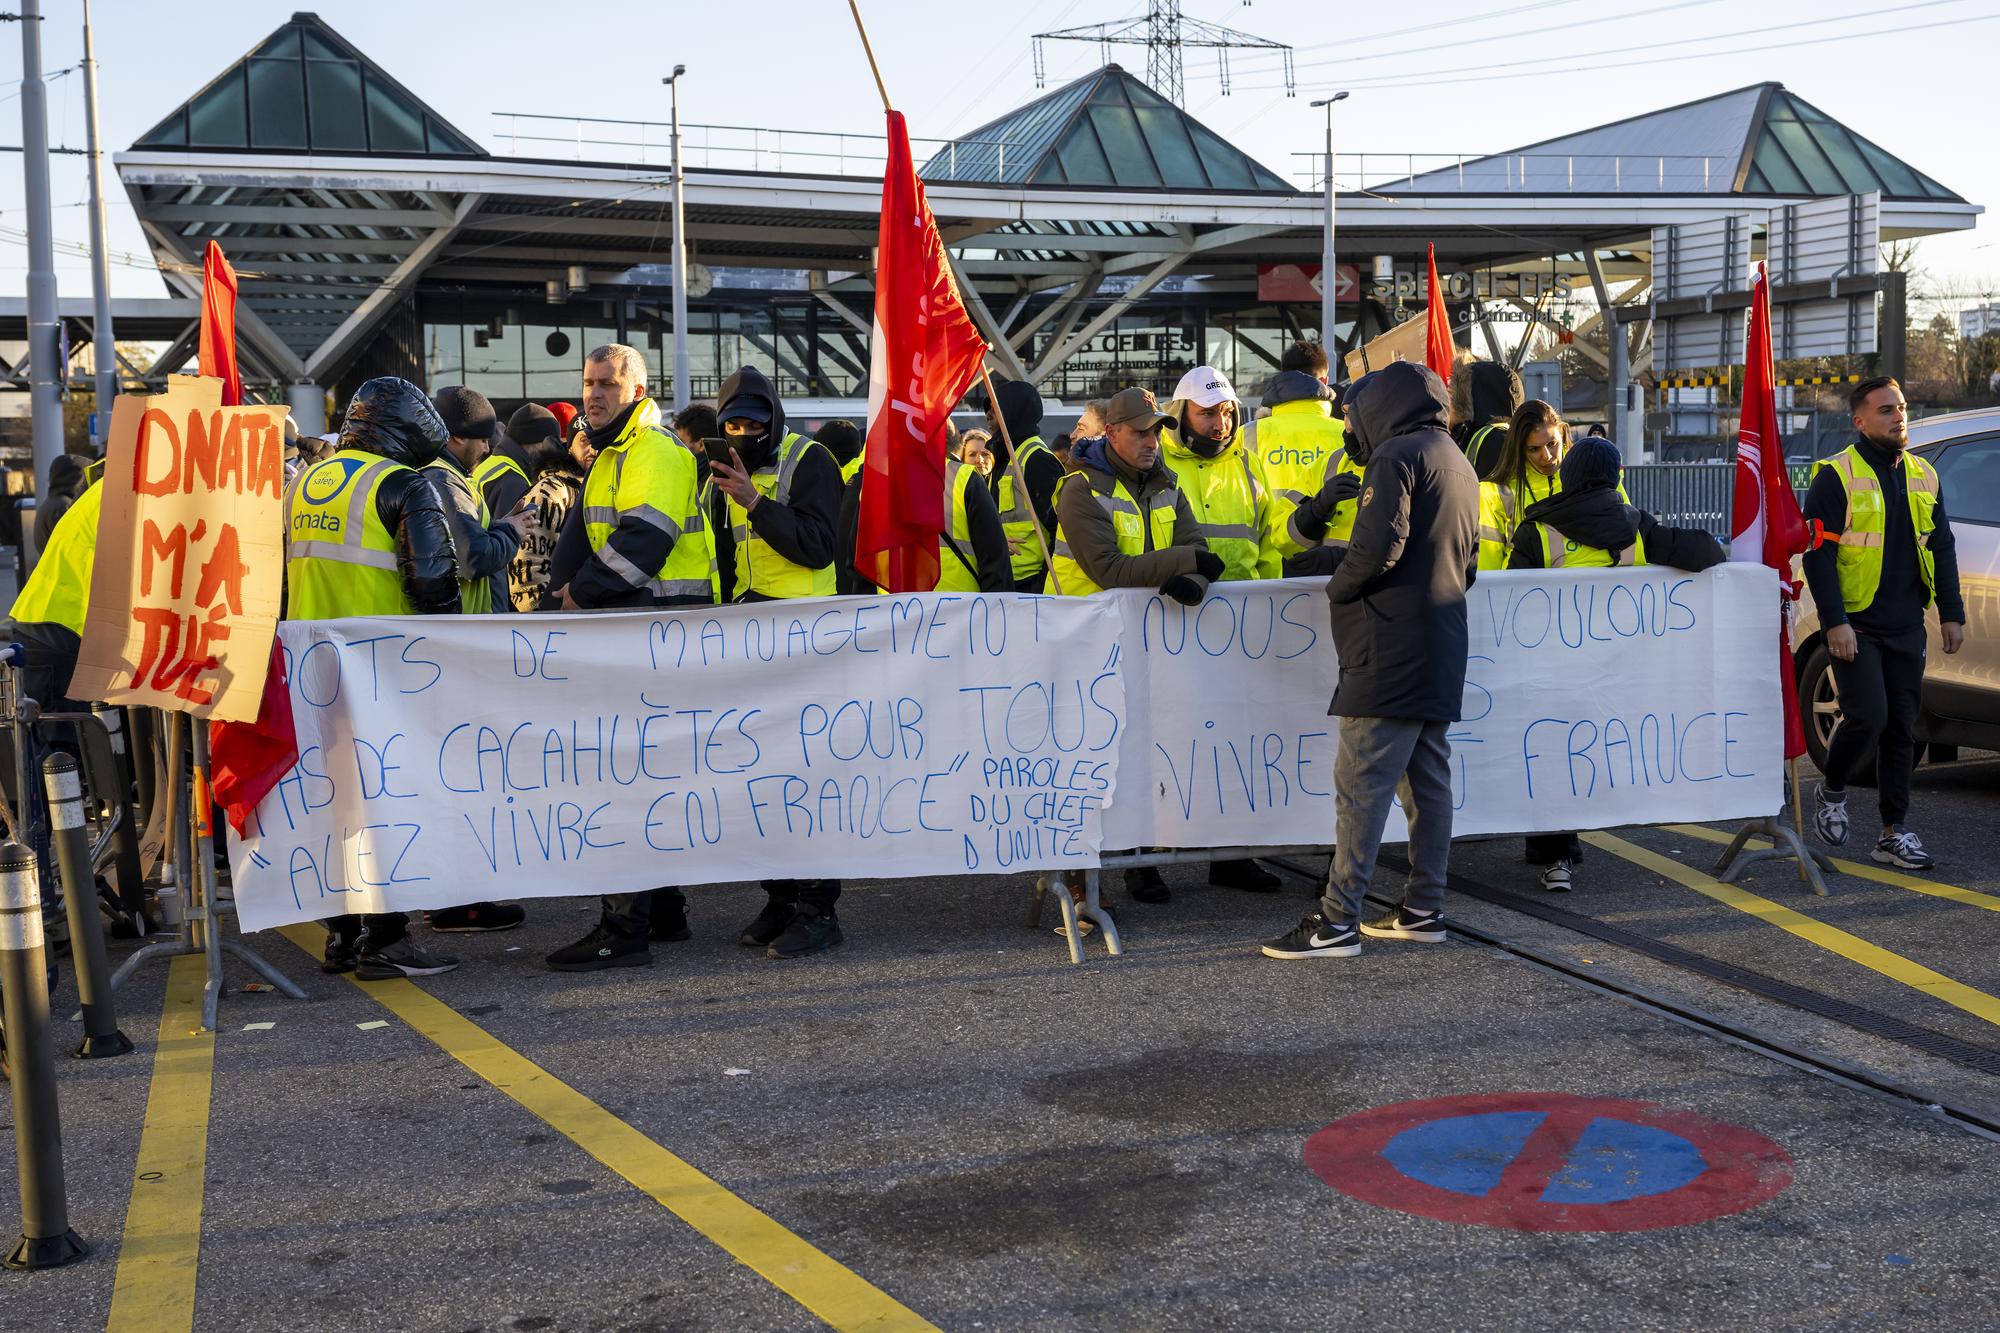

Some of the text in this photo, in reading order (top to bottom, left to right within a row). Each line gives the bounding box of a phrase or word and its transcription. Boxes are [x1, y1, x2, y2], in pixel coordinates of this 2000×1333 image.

[132, 407, 282, 500] DNATA
[312, 476, 337, 487] safety
[293, 510, 341, 532] dnata
[140, 518, 250, 616] M'A
[511, 629, 569, 681] DE
[650, 596, 1056, 671] MANAGEMENT
[1143, 579, 1696, 661] NOUS VOULONS
[253, 745, 335, 837] AS
[352, 733, 419, 800] DE
[799, 697, 925, 767] POUR
[983, 756, 1109, 791] PAROLES
[1524, 711, 1755, 799] FRANCE
[644, 786, 723, 852] EN
[970, 791, 1104, 826] DU CHEF
